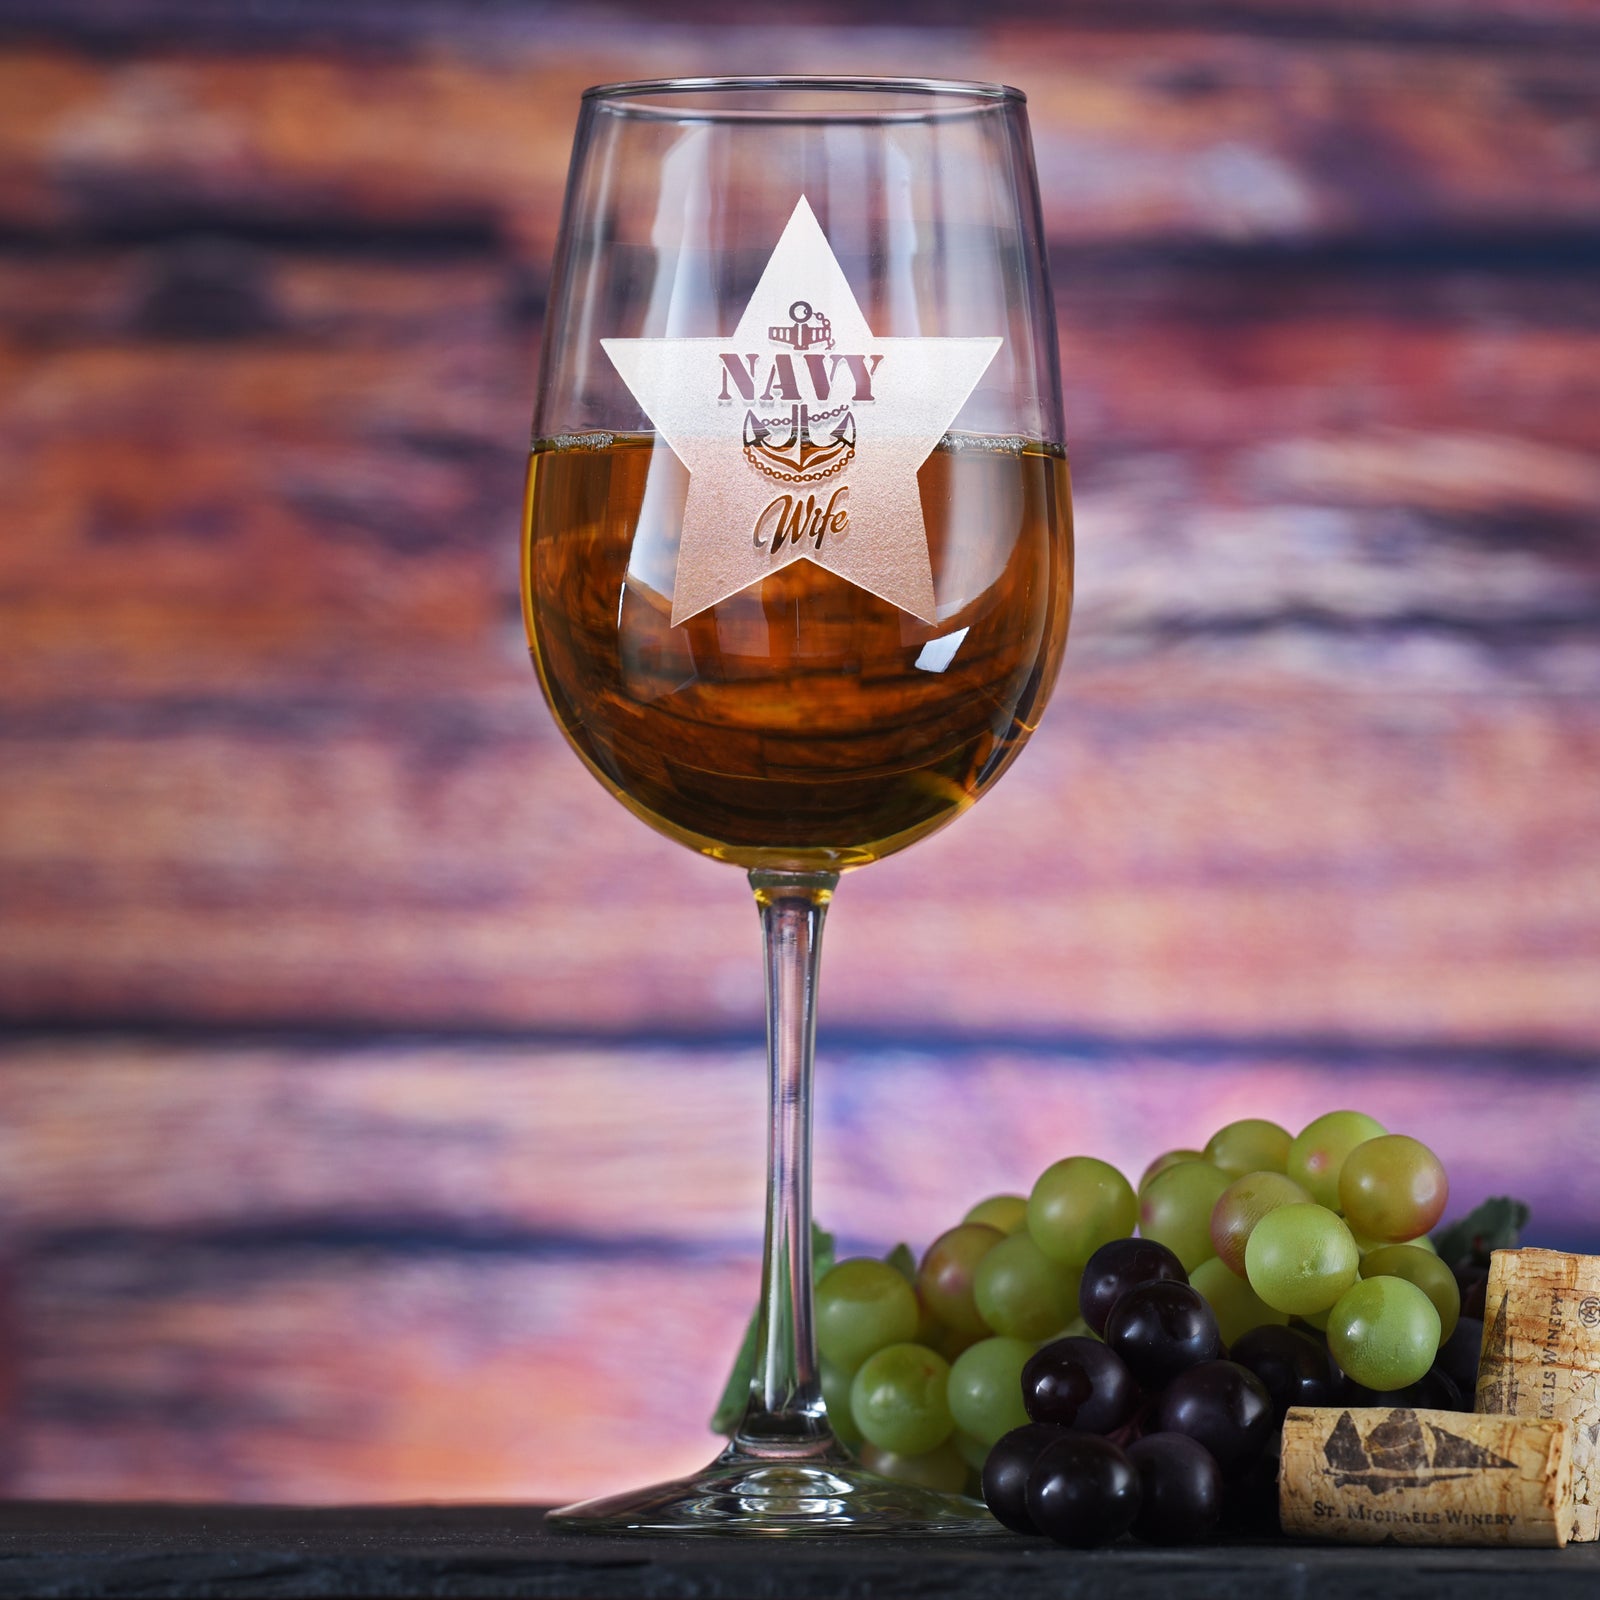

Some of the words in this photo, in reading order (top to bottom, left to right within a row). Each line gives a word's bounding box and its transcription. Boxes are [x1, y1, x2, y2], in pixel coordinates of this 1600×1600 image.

[717, 353, 884, 401] NAVY
[753, 486, 848, 554] Wife
[1445, 1509, 1517, 1526] WINERY
